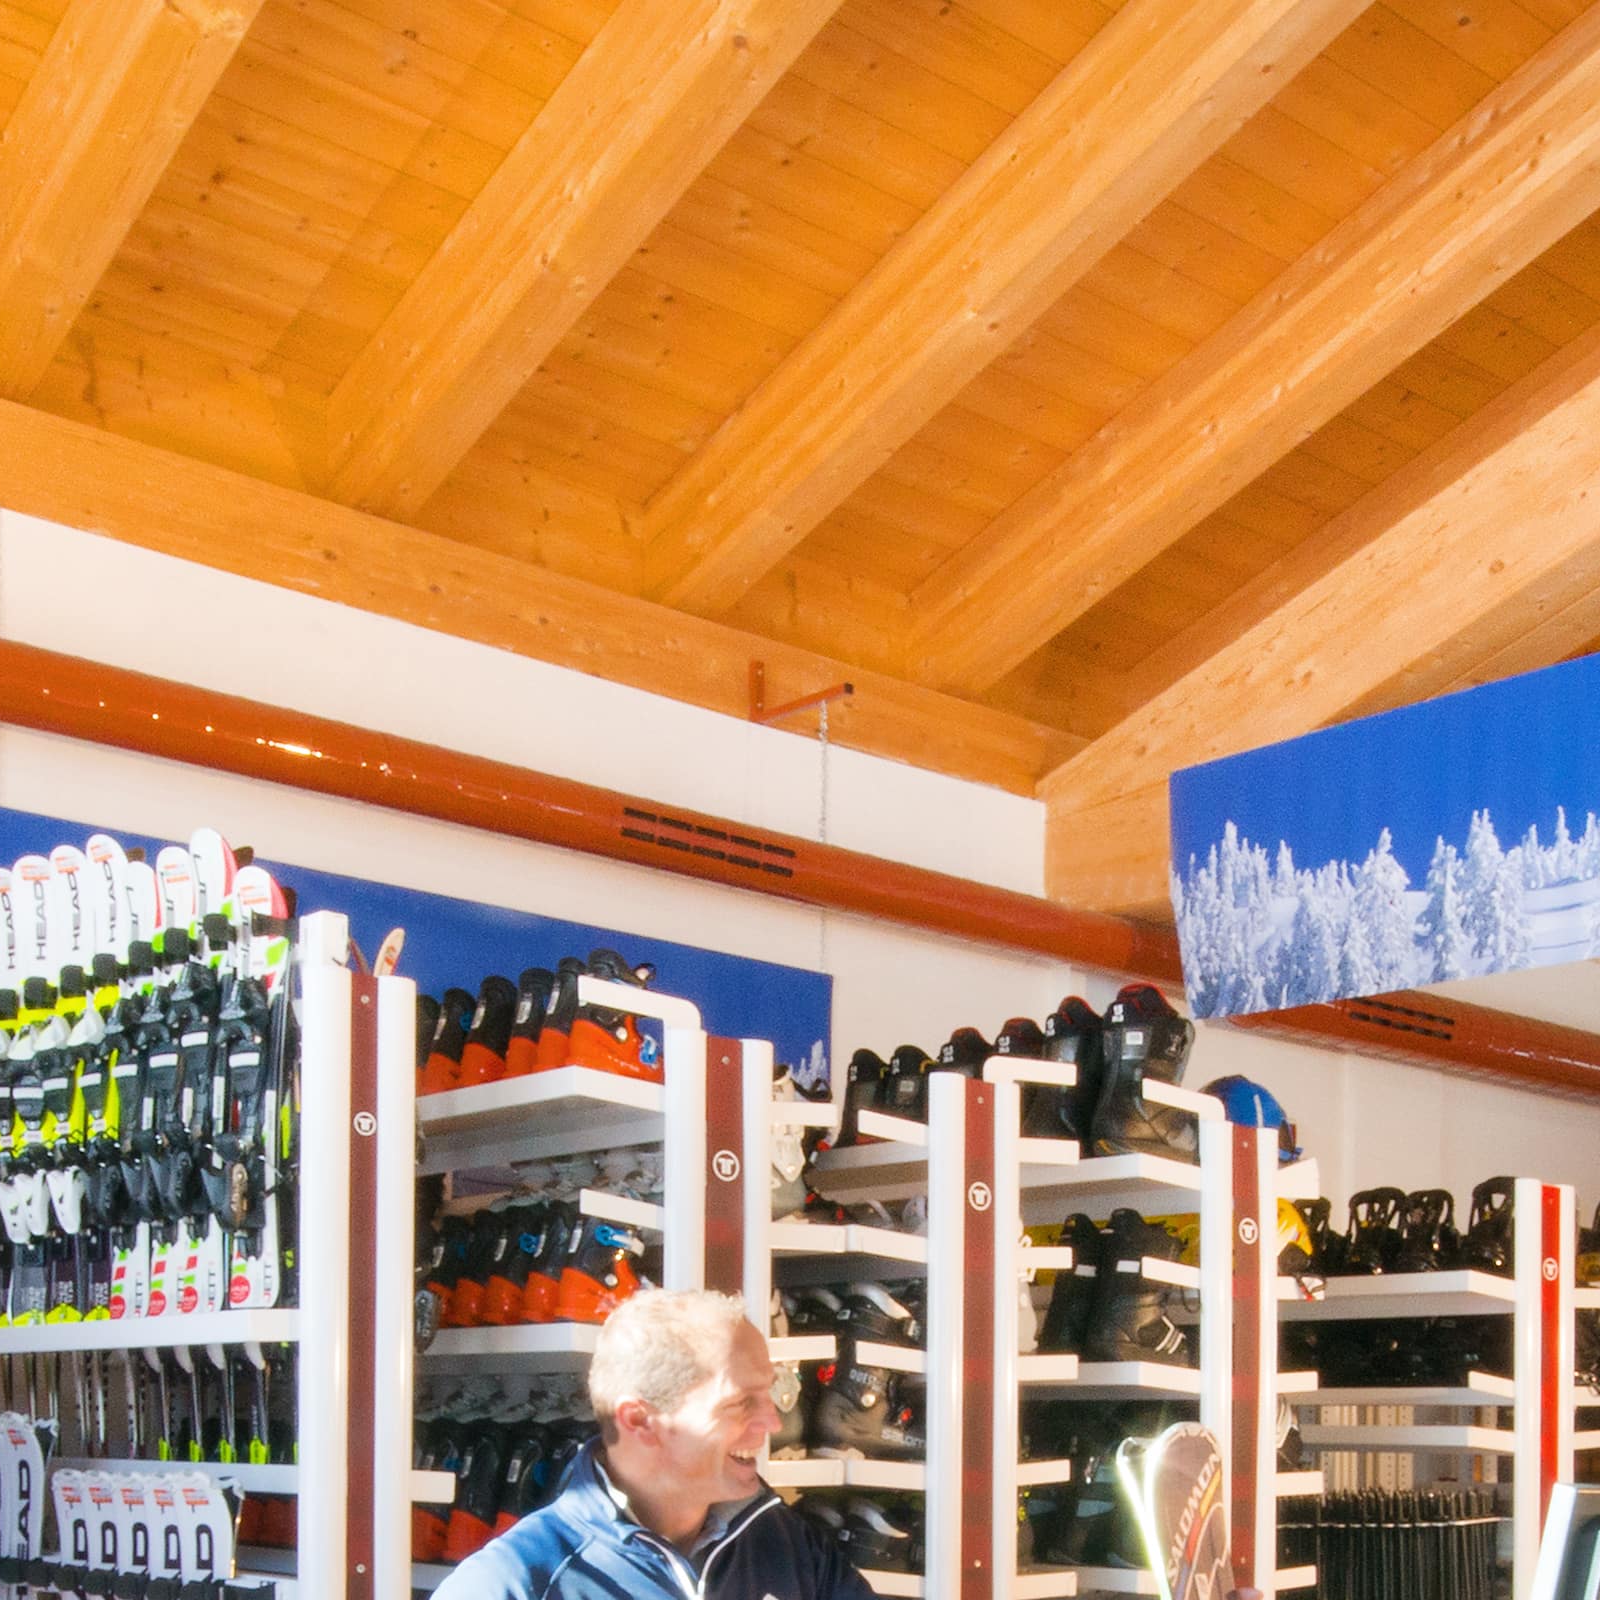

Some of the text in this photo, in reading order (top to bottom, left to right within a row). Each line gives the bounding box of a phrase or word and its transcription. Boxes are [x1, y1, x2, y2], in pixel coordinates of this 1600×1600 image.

[1, 891, 15, 970] HEAD
[33, 880, 47, 960] HEAD
[68, 871, 80, 951] HEAD
[103, 861, 117, 943] HEAD
[1168, 1452, 1221, 1588] SALOMON
